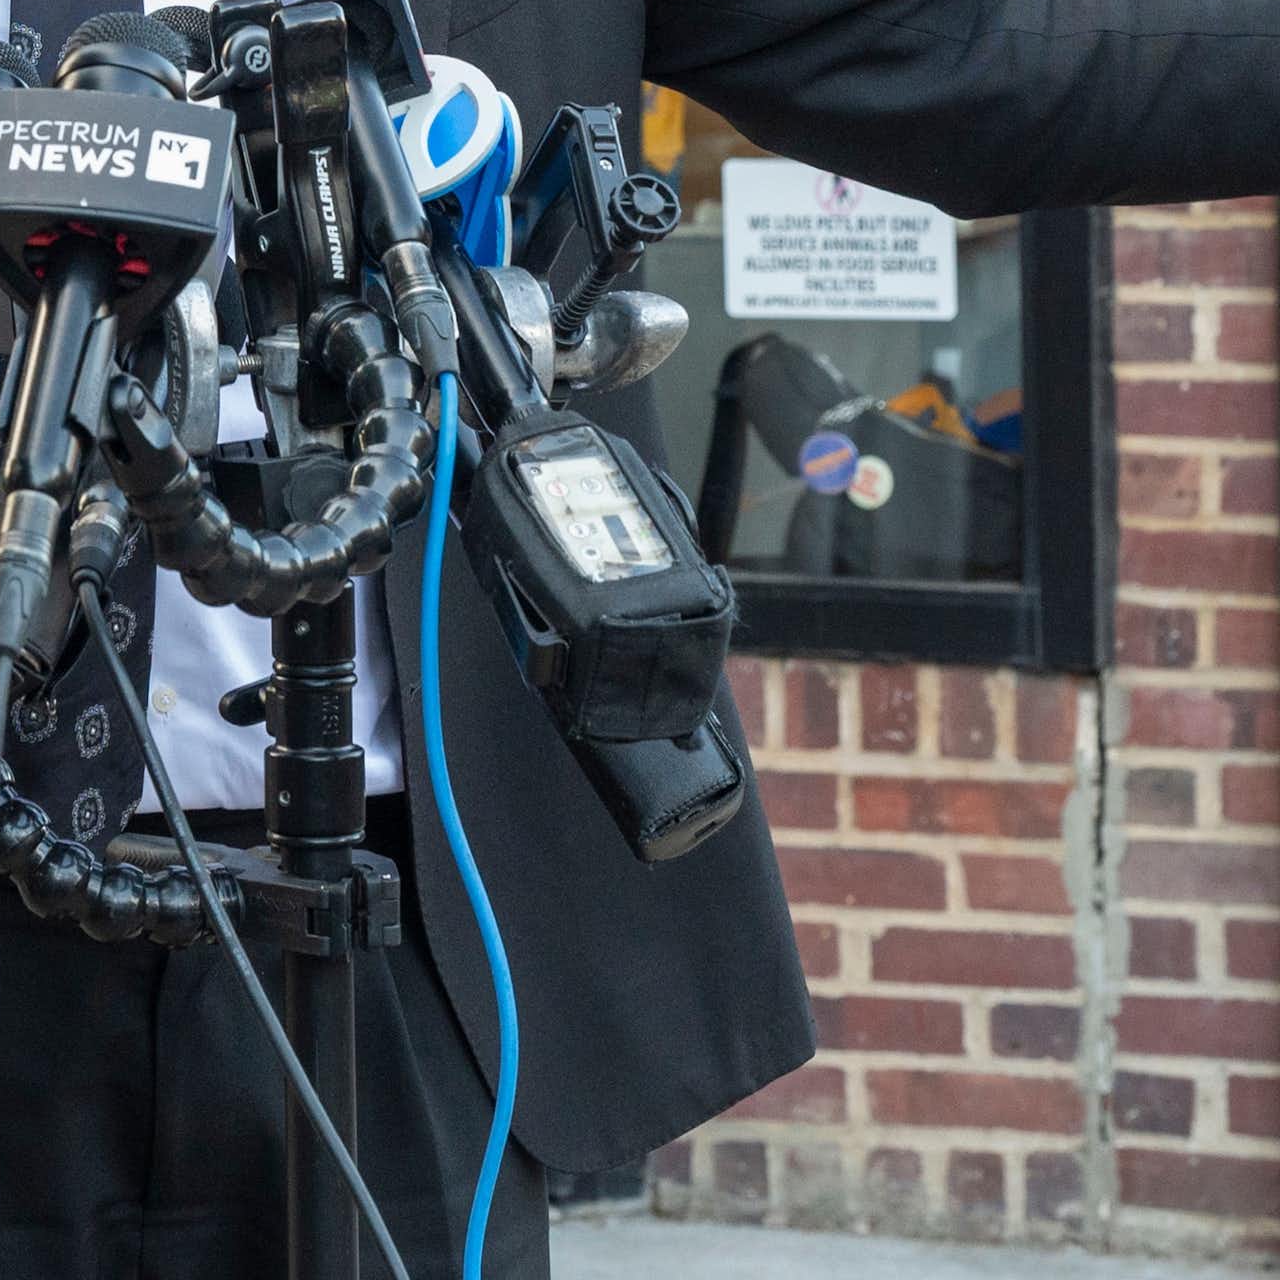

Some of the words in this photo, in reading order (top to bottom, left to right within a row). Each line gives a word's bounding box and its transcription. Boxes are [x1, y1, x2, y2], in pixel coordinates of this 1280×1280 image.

[8, 143, 136, 178] NEWS
[158, 138, 188, 156] NY
[183, 160, 199, 180] 1
[316, 157, 336, 222] CLAMPS
[326, 225, 345, 279] NINJA
